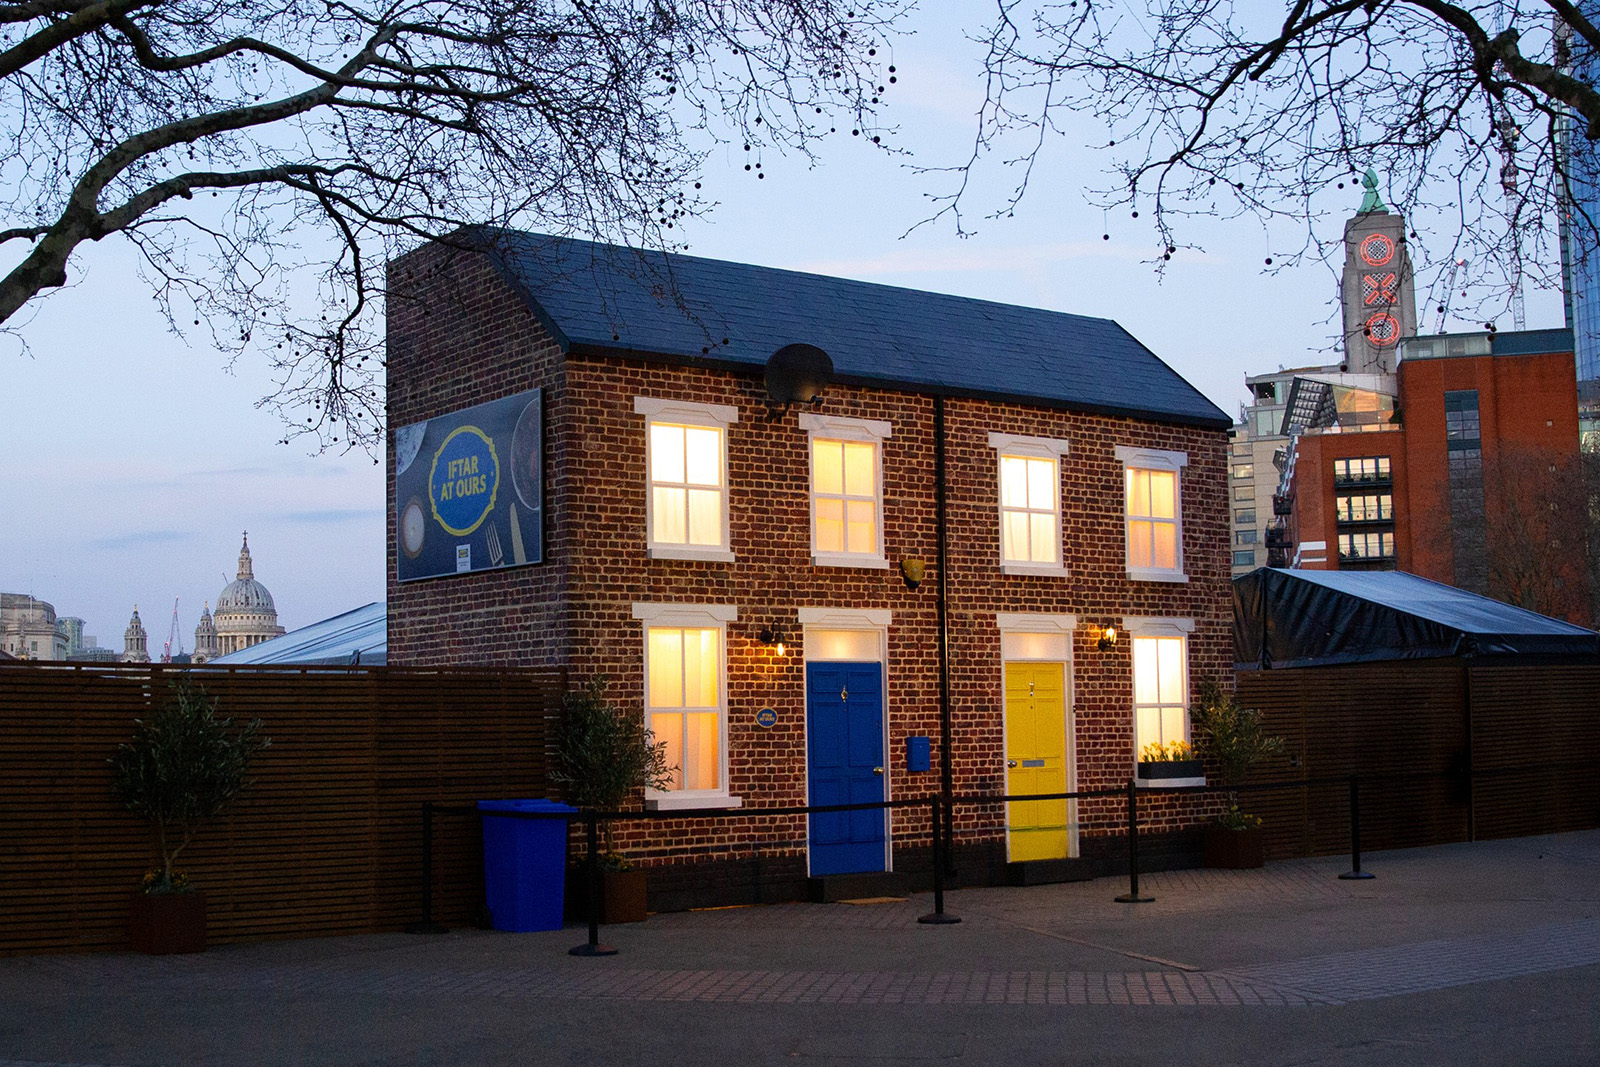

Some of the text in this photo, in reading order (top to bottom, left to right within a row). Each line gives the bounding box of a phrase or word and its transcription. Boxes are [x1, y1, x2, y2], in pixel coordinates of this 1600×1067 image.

[448, 456, 478, 479] IFTAR
[441, 474, 486, 502] AT OURS
